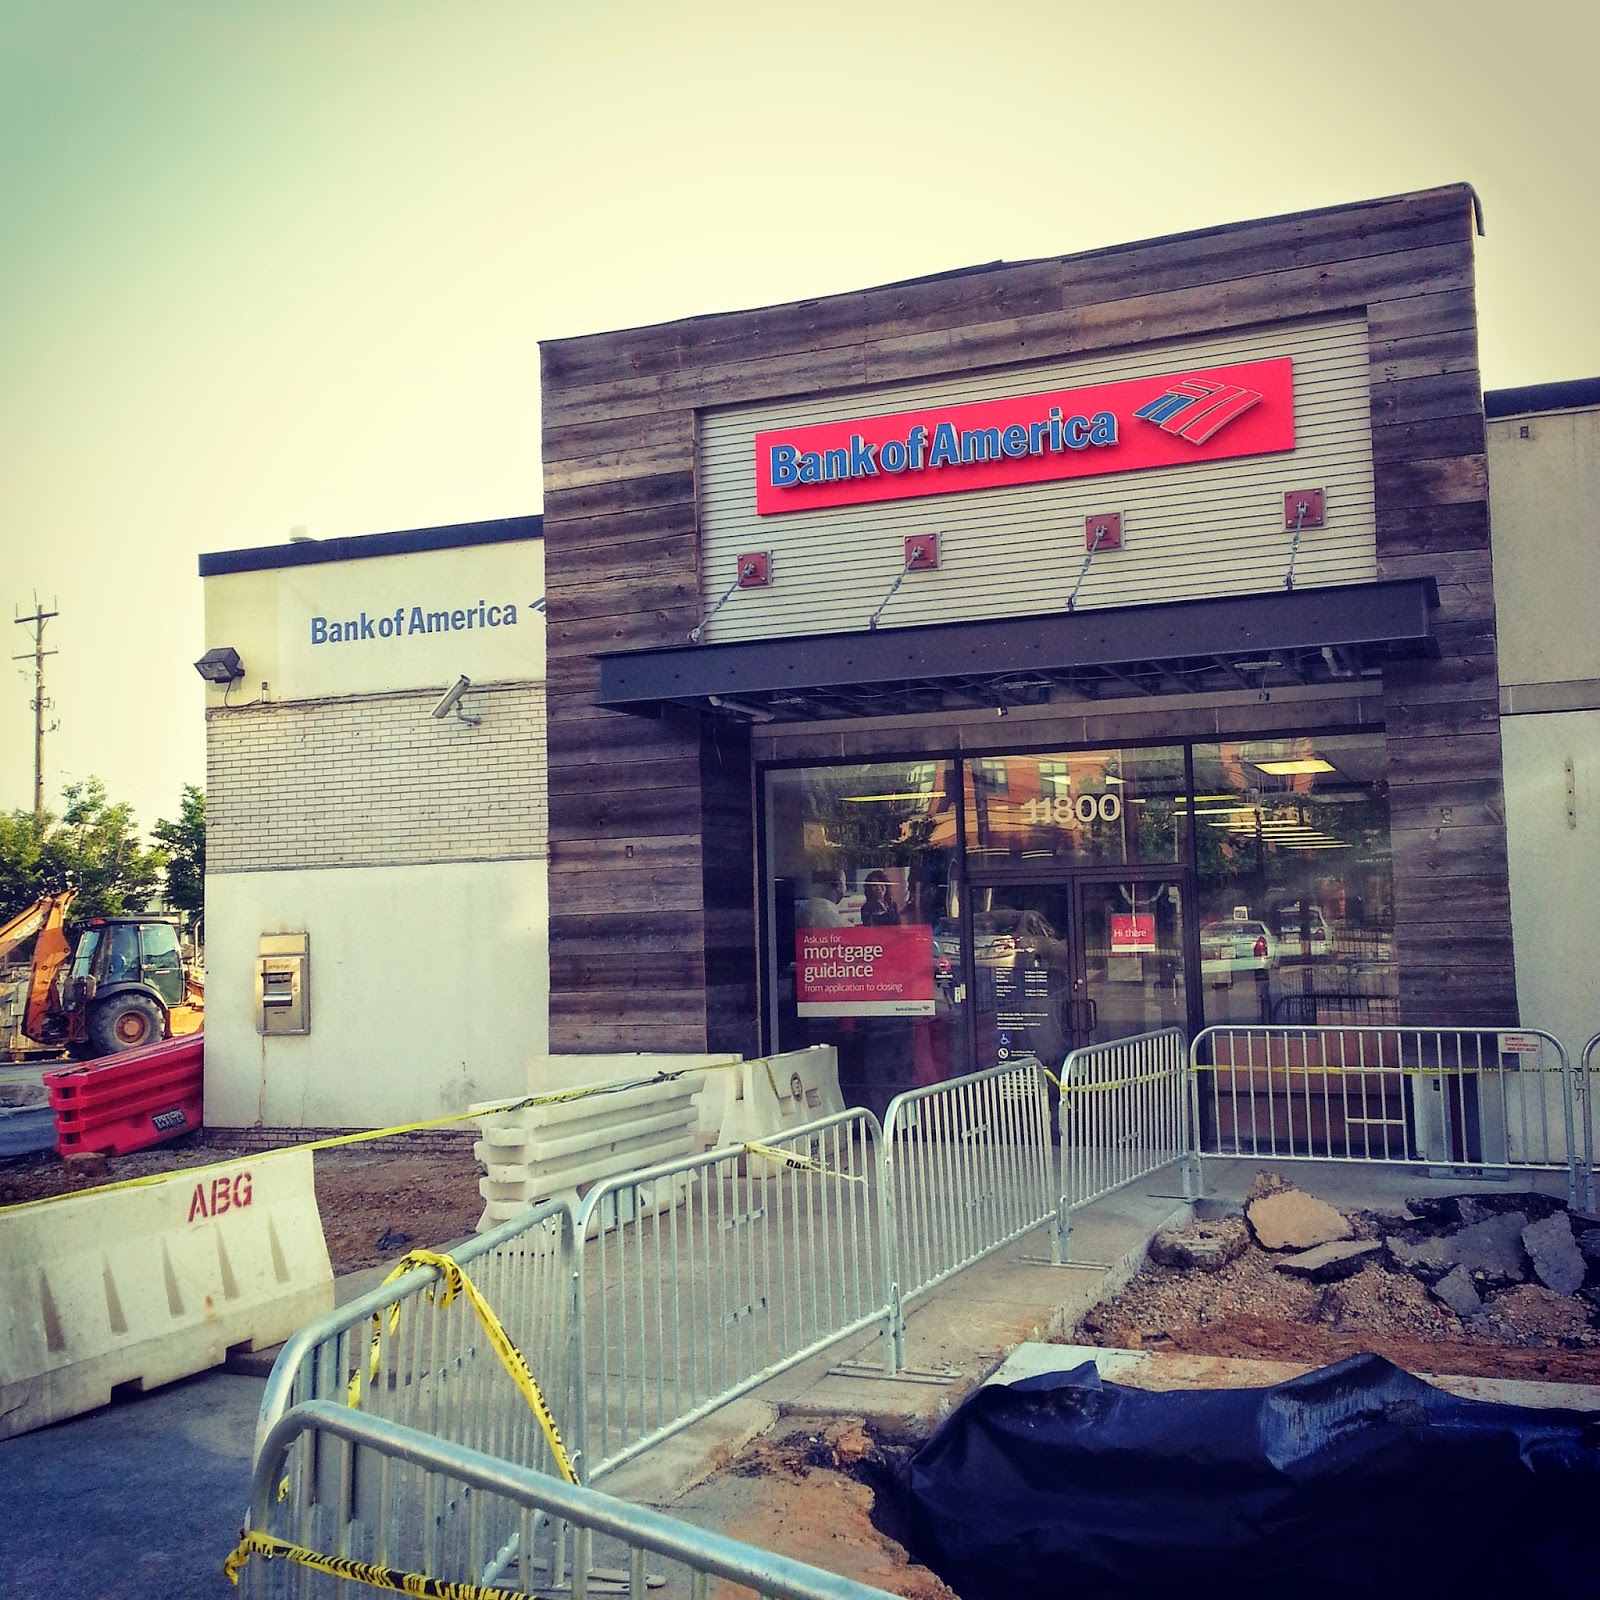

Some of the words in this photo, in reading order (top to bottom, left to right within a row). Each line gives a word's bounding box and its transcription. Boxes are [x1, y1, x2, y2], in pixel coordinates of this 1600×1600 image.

[770, 434, 878, 488] Bank
[881, 425, 929, 474] of
[929, 408, 1119, 468] America
[311, 612, 376, 645] Bank
[378, 608, 405, 638] of
[408, 600, 518, 635] America
[1020, 793, 1121, 824] 11800
[803, 935, 818, 944] Ask
[819, 936, 829, 944] us
[830, 934, 842, 943] for
[1113, 928, 1123, 938] Hi
[1125, 928, 1148, 938] there
[803, 944, 884, 963] mortgage
[803, 961, 874, 983] guidance
[804, 983, 823, 993] from
[824, 983, 865, 994] application
[866, 983, 875, 992] to
[876, 982, 903, 993] closing
[188, 1172, 253, 1223] ABG
